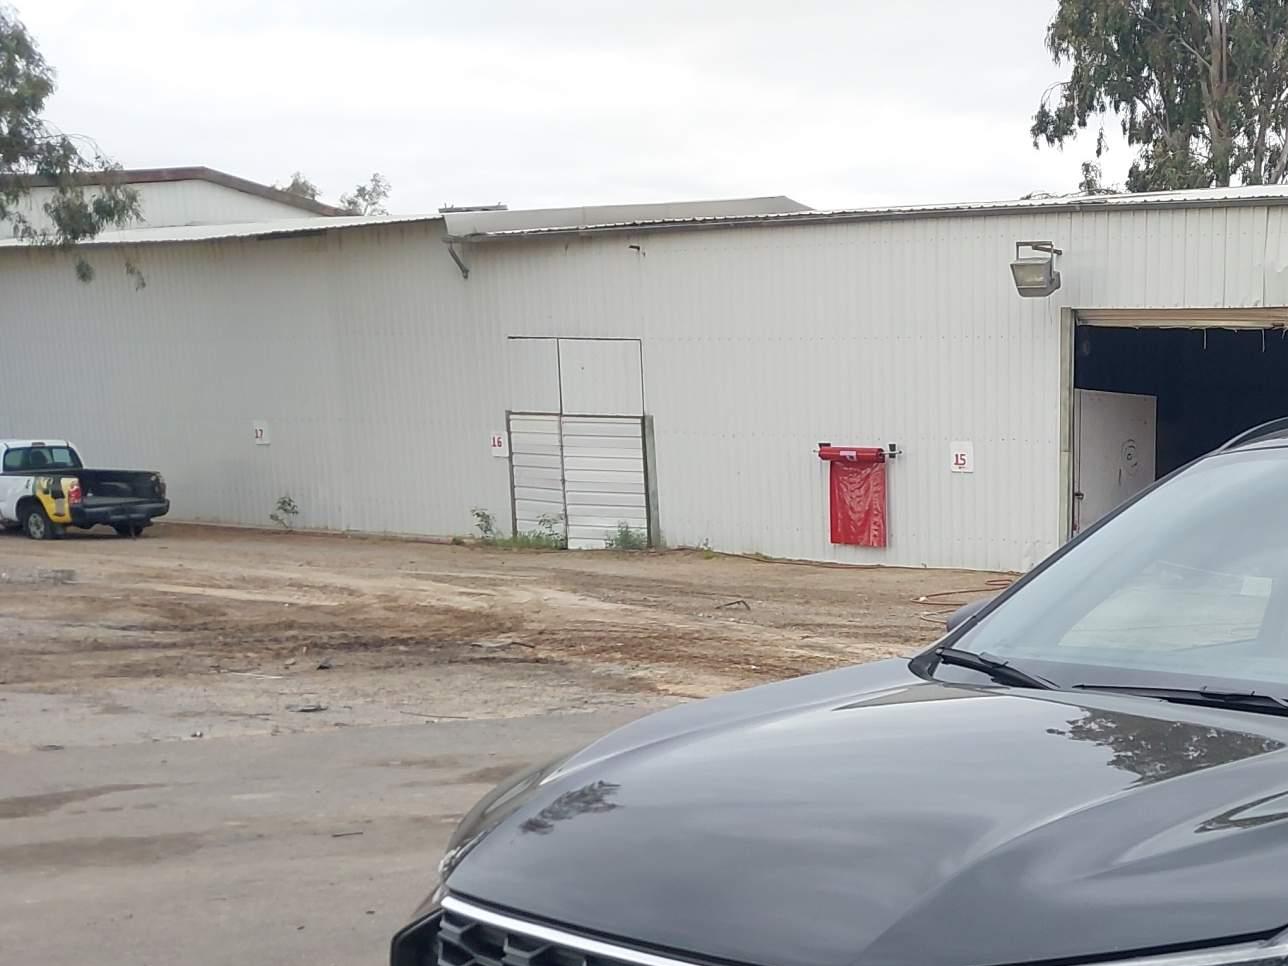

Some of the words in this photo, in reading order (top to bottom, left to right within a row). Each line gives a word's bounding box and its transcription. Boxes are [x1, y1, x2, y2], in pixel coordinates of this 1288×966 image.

[255, 428, 264, 439] 17
[491, 436, 503, 448] 16
[953, 453, 966, 466] 15
